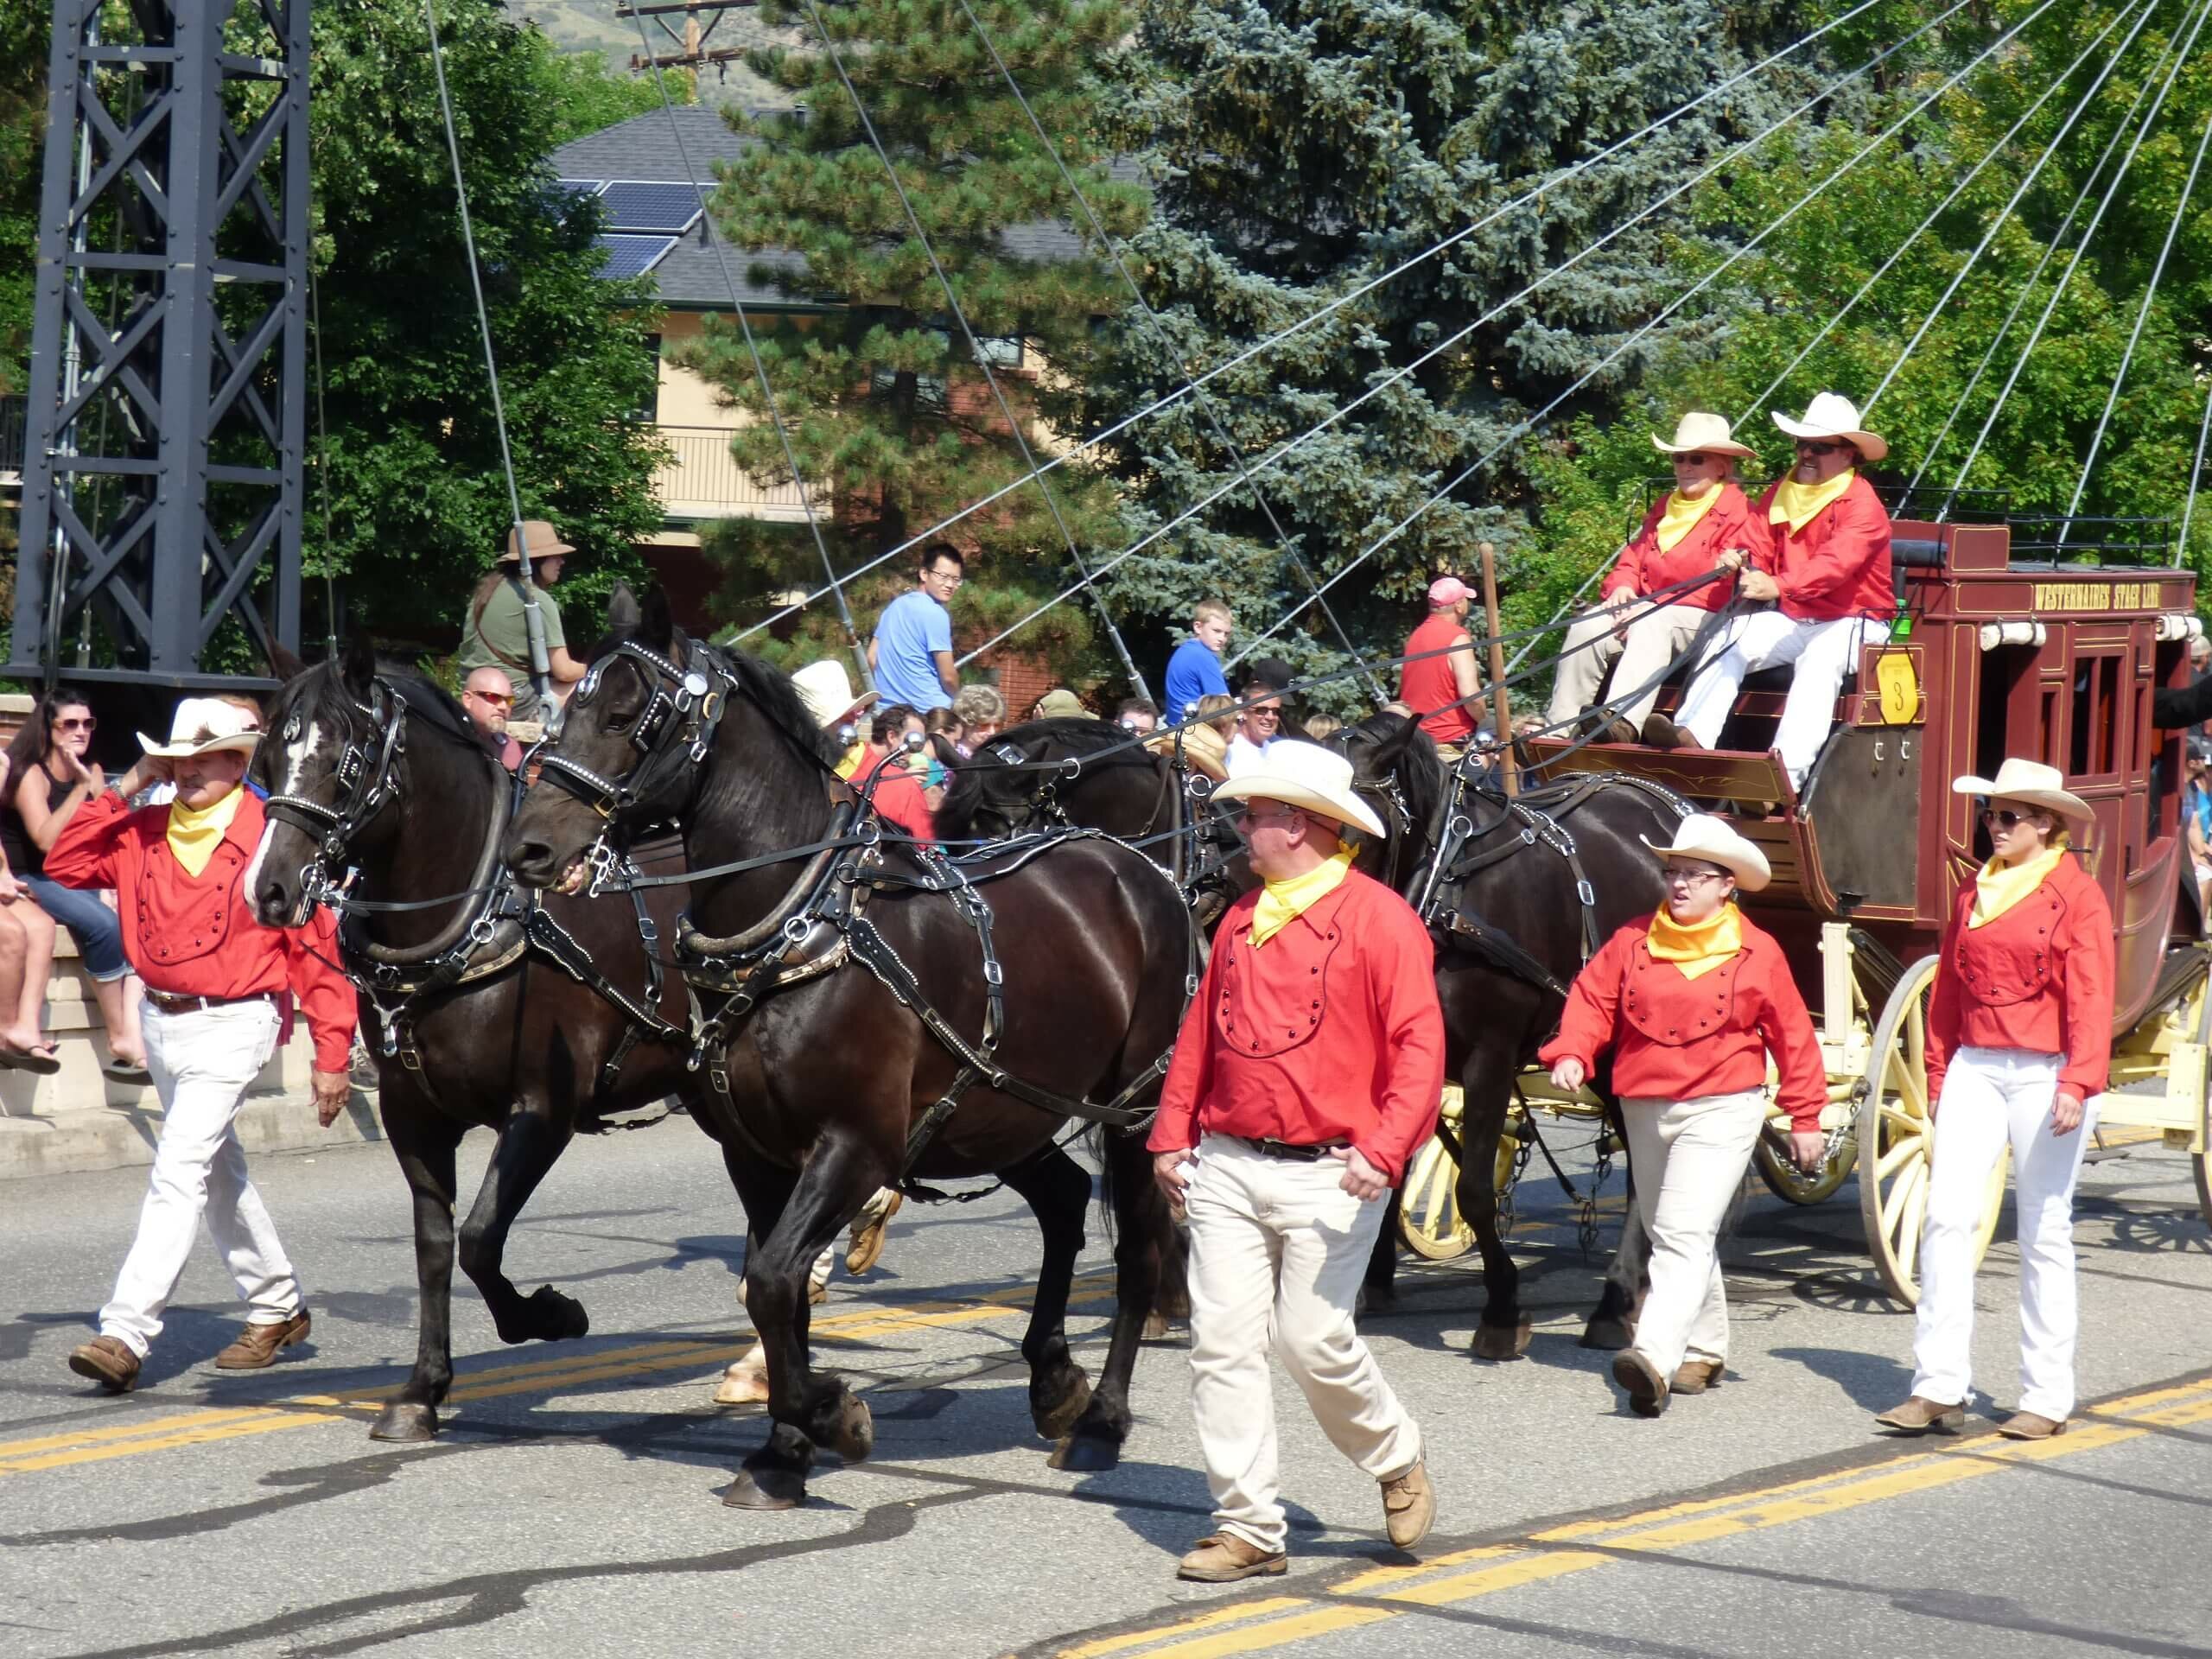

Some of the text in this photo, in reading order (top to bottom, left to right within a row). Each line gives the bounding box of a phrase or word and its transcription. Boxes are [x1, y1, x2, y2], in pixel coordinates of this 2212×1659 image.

[2035, 584, 2110, 610] WESTERNAIRES
[2113, 583, 2140, 609] STAGE
[1893, 682, 1904, 711] 3
